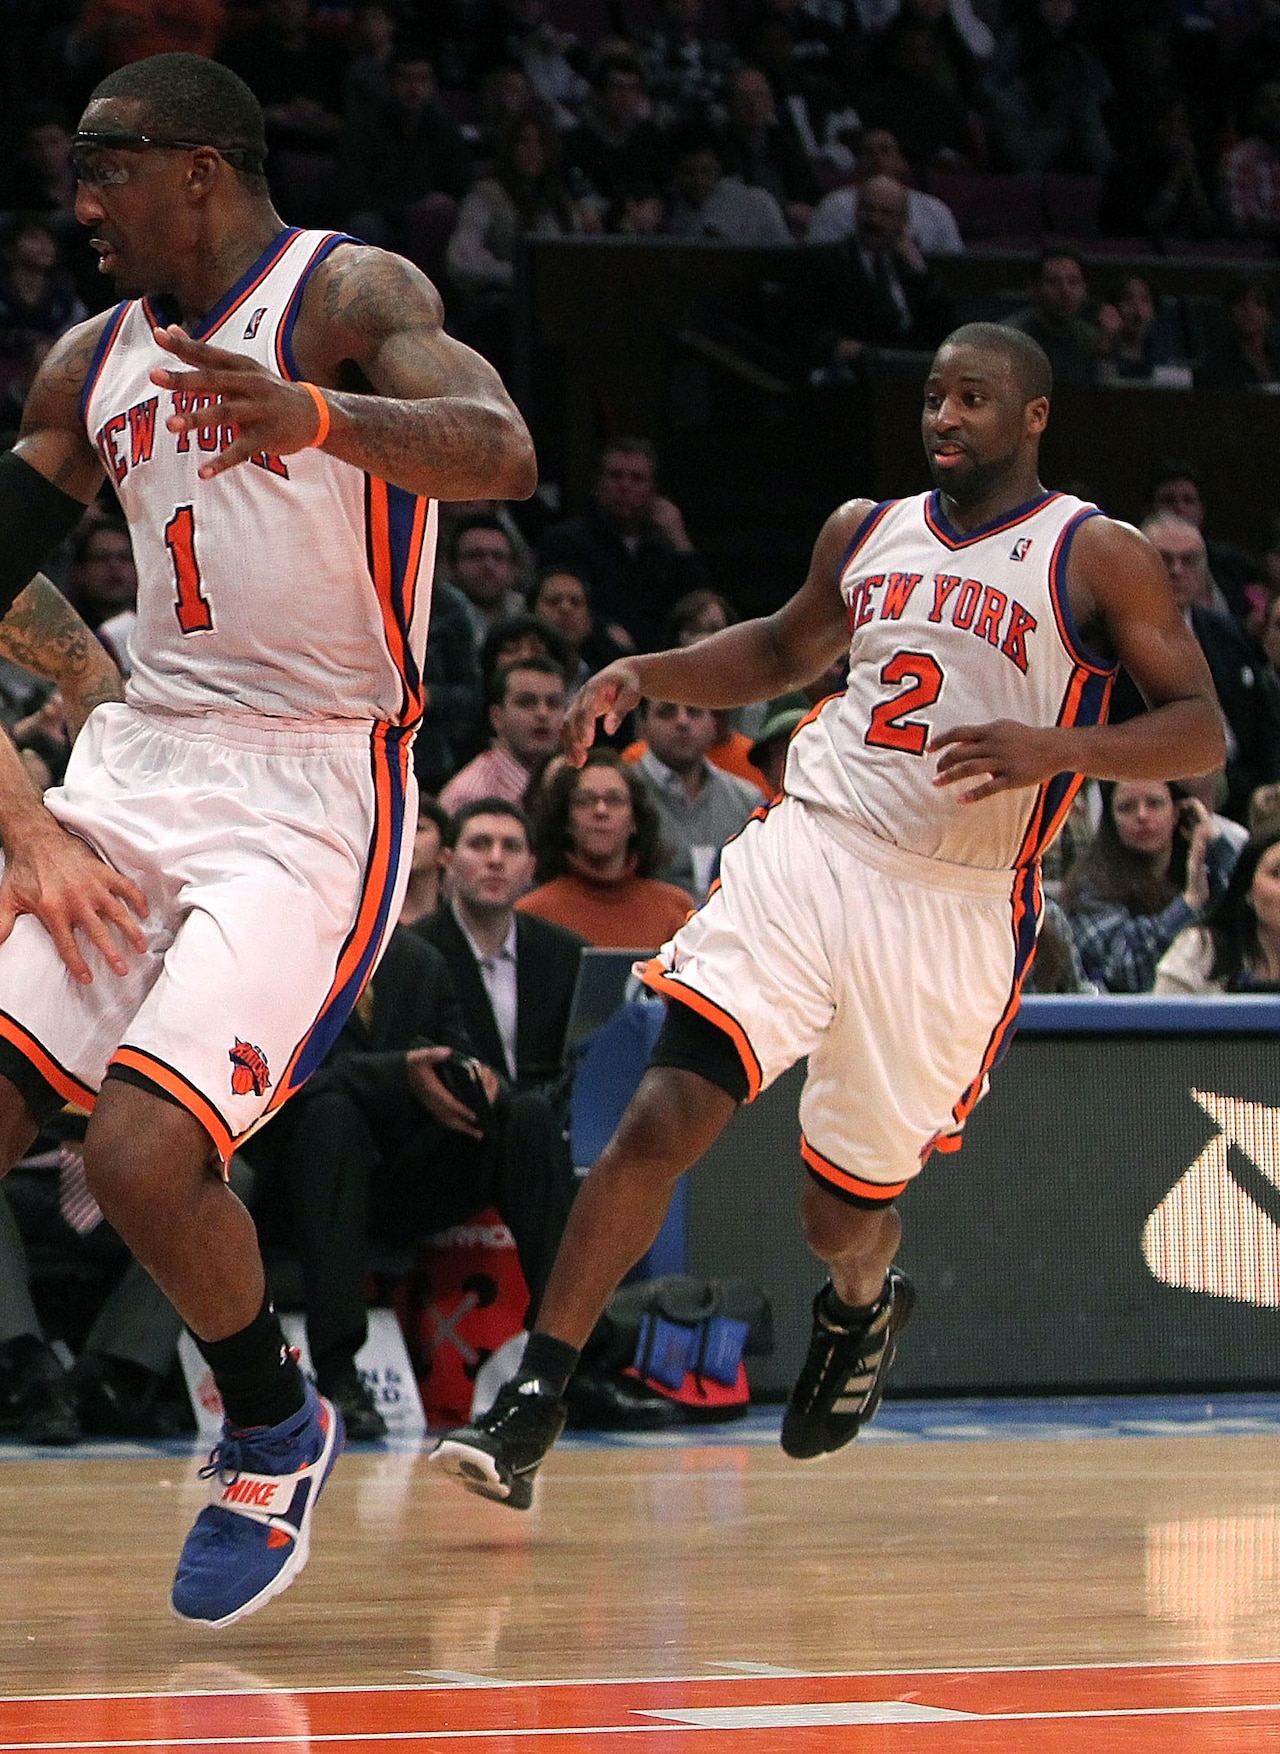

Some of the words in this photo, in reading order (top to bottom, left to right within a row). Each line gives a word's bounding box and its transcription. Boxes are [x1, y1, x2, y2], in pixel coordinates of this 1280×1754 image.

[165, 504, 213, 634] 1
[928, 574, 1038, 675] YORK
[864, 650, 945, 756] 2
[222, 1480, 281, 1507] NIKE
